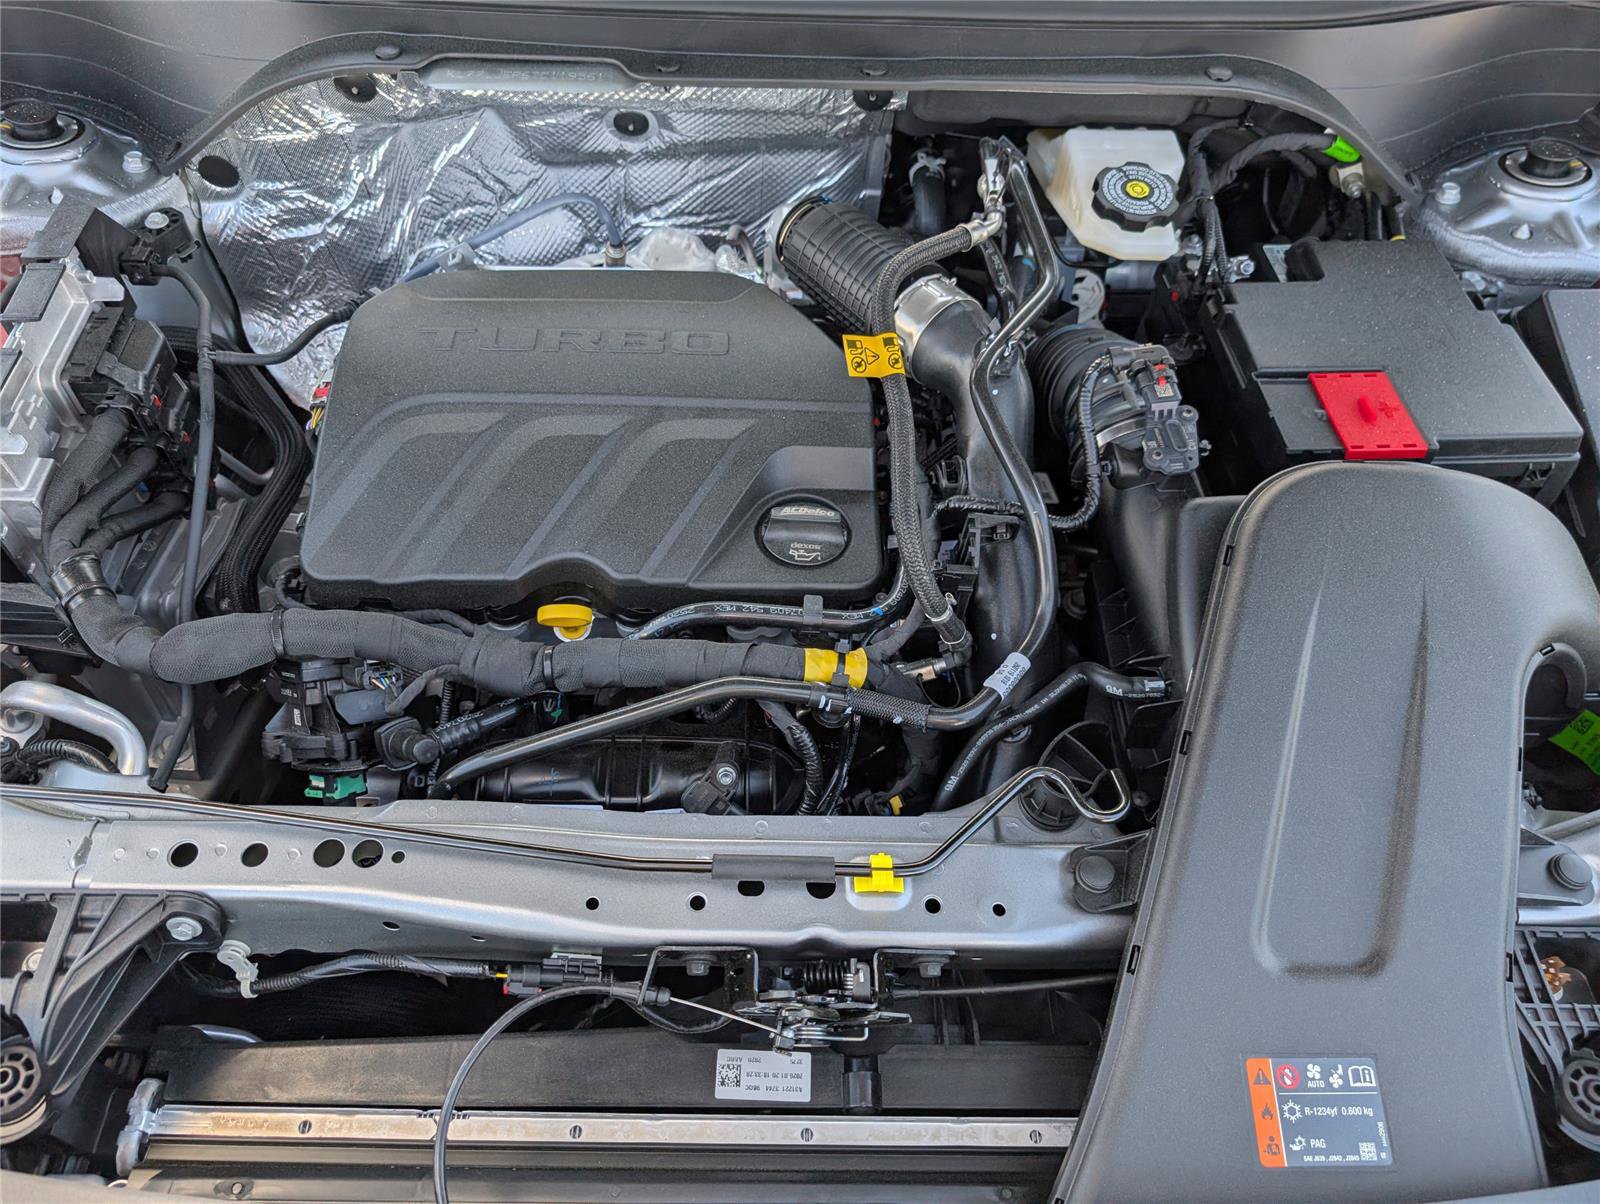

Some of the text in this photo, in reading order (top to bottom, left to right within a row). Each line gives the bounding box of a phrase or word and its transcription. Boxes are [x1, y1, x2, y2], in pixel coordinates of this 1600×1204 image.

[416, 327, 730, 355] TURBO
[781, 506, 835, 516] ACDelco
[790, 542, 821, 550] dexos
[1307, 1080, 1325, 1088] AUTO
[1304, 1106, 1373, 1117] R-1234yf 0.600 kg
[1310, 1138, 1326, 1148] PAG
